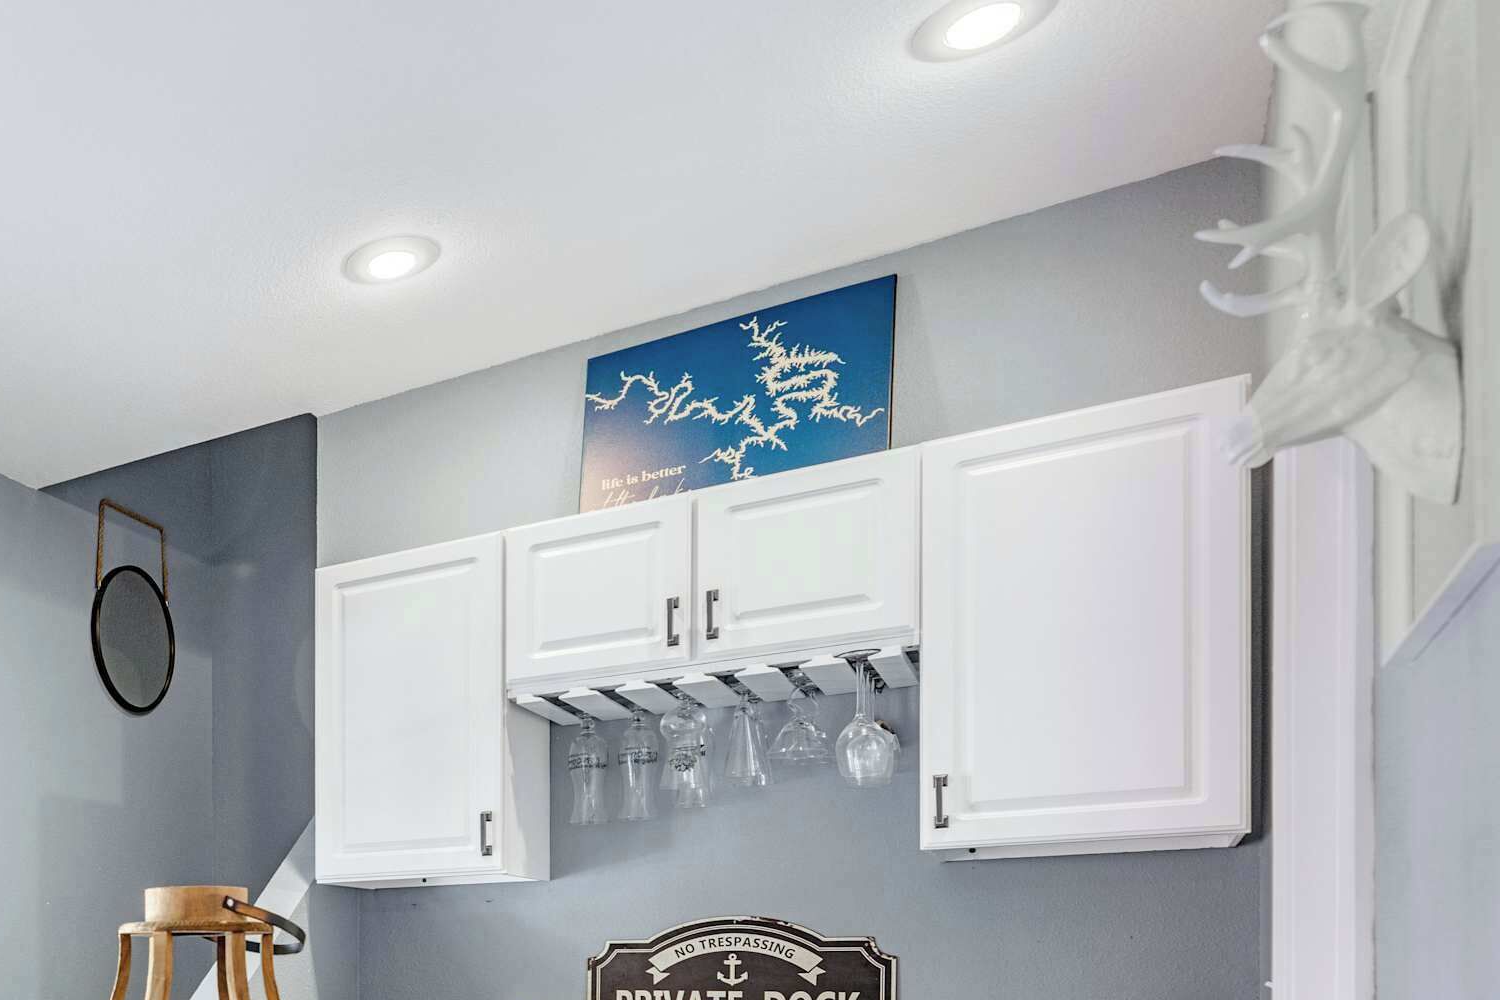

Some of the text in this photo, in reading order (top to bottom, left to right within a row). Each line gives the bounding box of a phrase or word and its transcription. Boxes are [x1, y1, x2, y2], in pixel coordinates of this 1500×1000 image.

[601, 465, 687, 491] life is better
[674, 936, 797, 959] NO TRESPASSING
